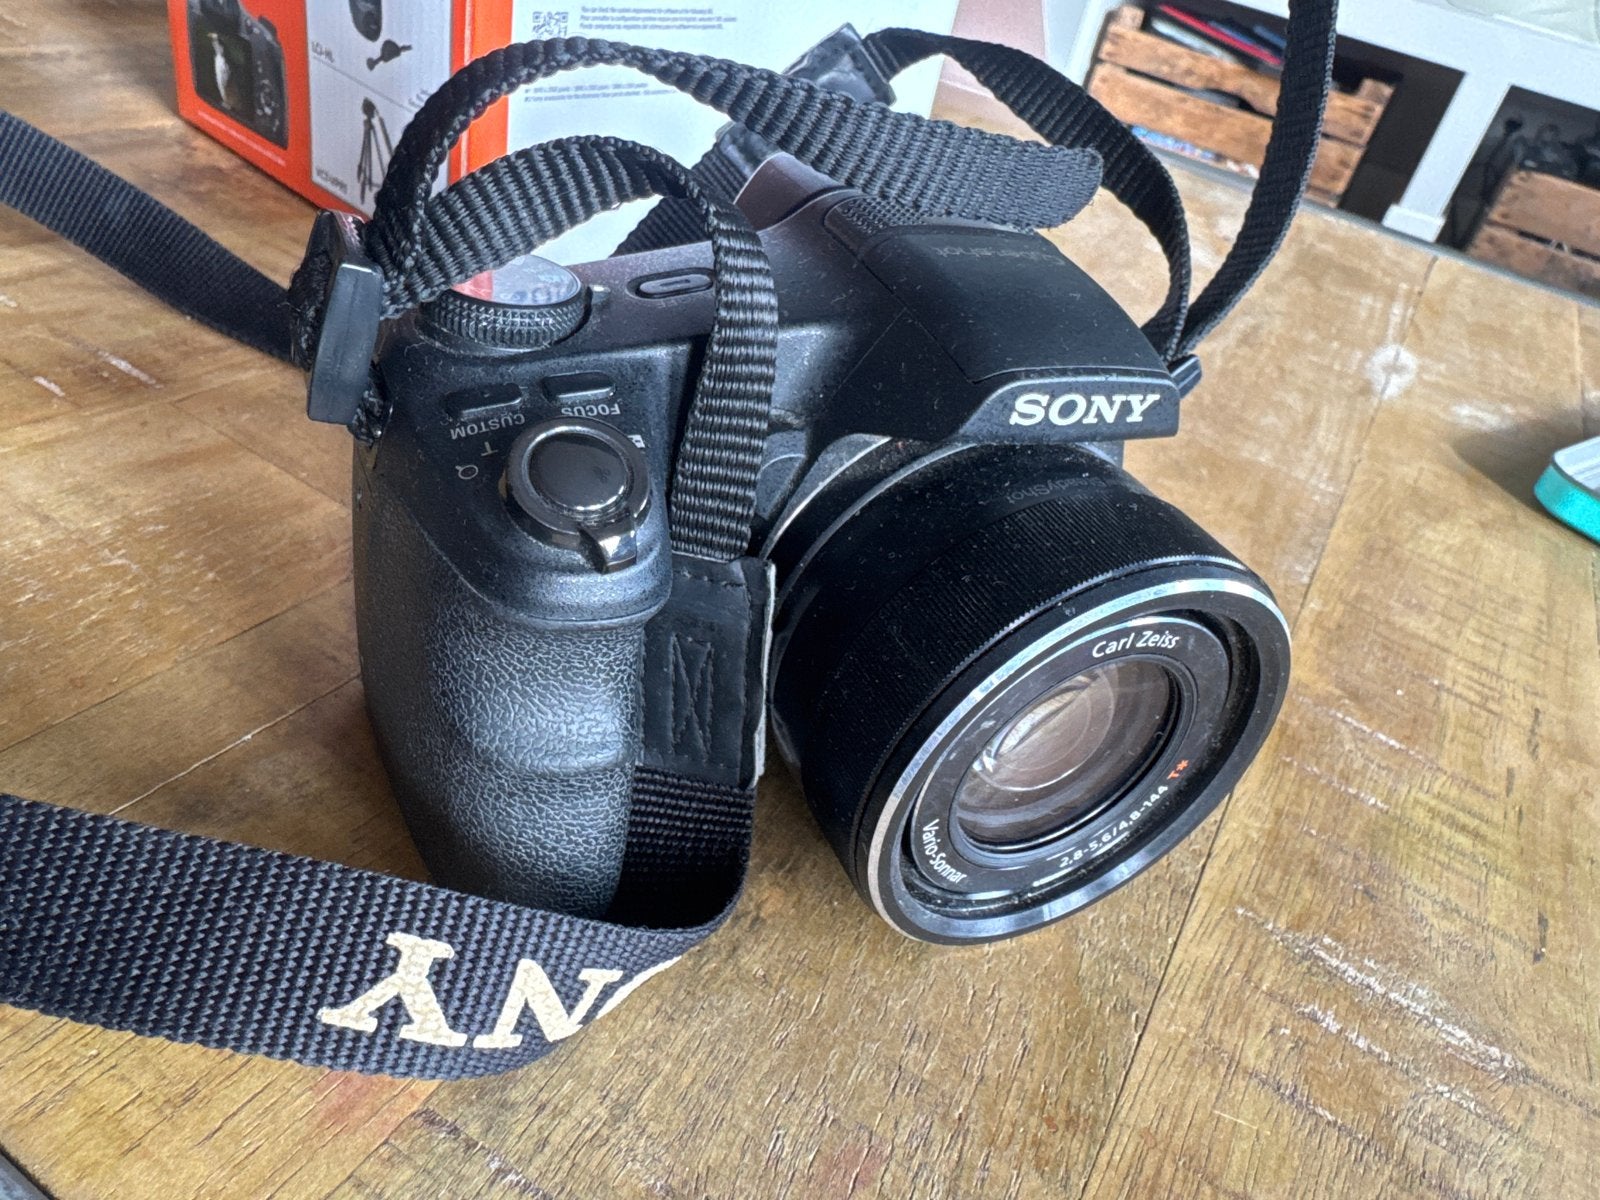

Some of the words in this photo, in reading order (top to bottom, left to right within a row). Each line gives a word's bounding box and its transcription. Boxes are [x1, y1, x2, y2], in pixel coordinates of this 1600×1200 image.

[561, 403, 621, 416] FOCUS
[1009, 393, 1160, 426] SONY
[450, 413, 526, 440] CUSTOM
[1092, 632, 1135, 658] Carl
[1136, 630, 1180, 649] Zeiss
[922, 818, 968, 884] Vario-Sonnar
[317, 931, 682, 1048] NY
